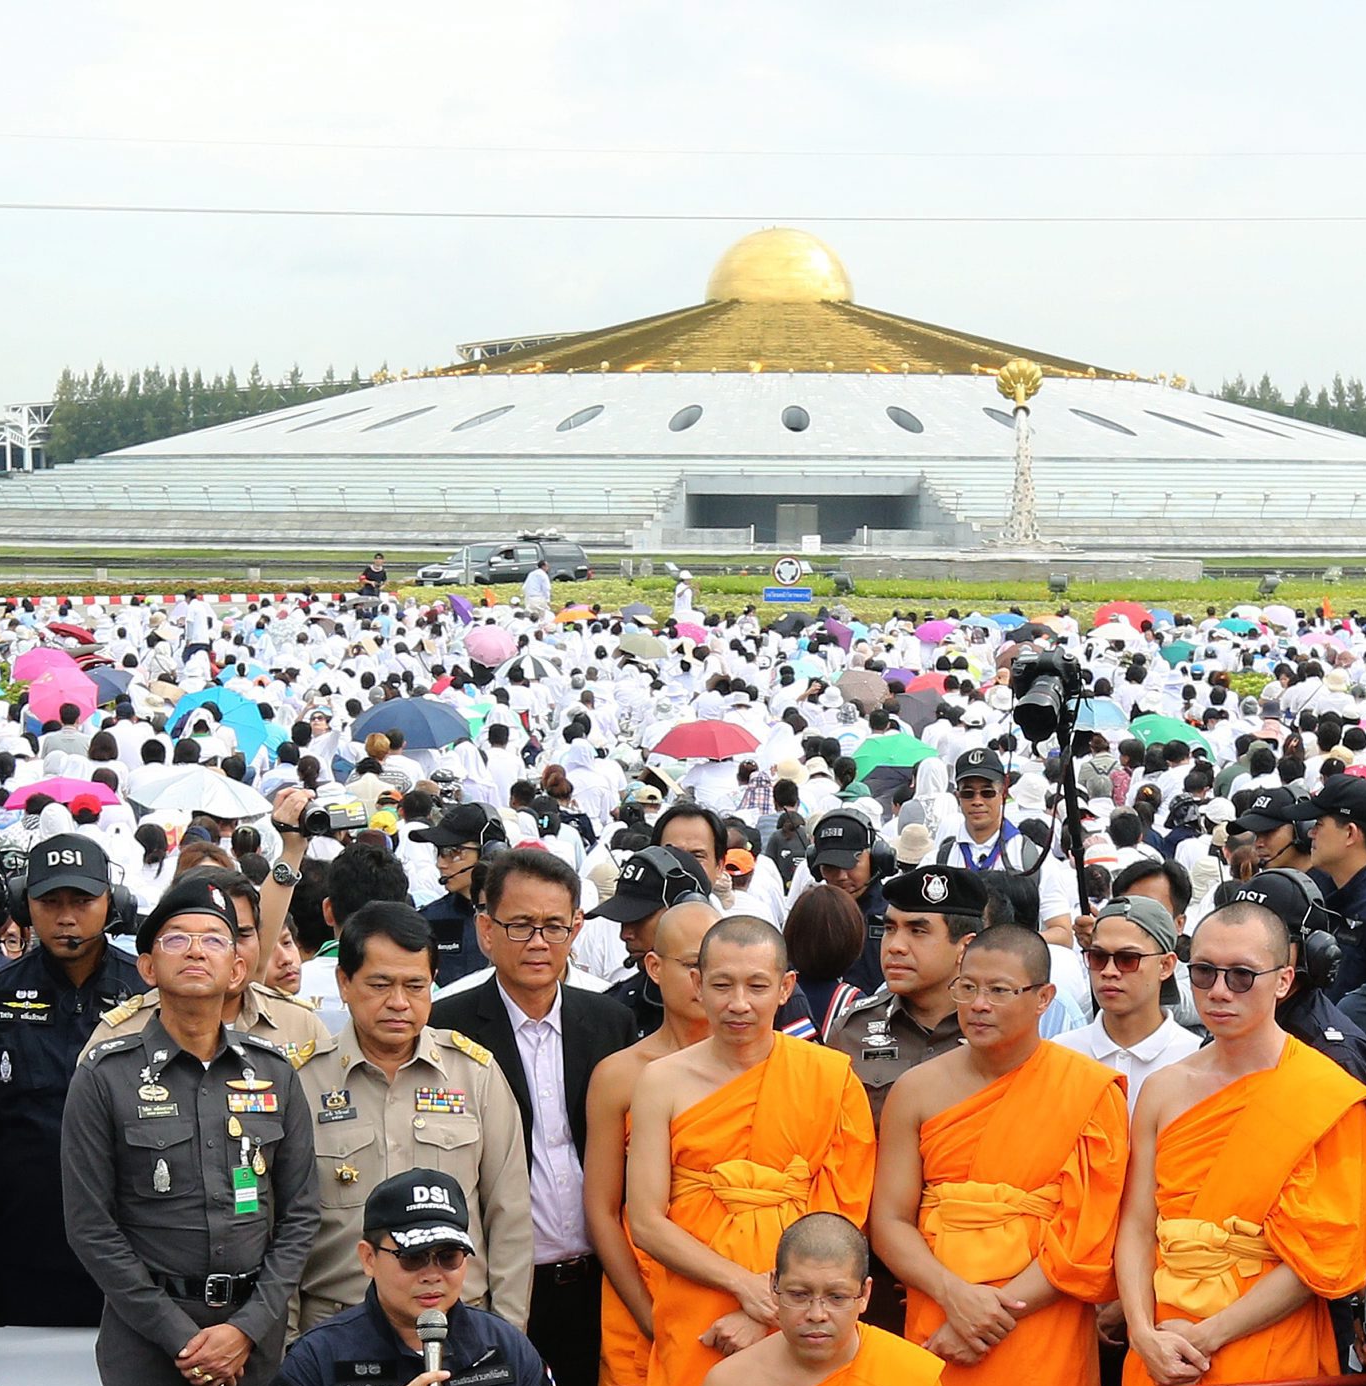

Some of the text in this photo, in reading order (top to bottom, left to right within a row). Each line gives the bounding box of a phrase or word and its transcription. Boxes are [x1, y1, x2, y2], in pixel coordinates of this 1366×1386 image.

[47, 850, 84, 868] DSI
[623, 864, 645, 881] SI
[412, 1185, 450, 1204] DSI
